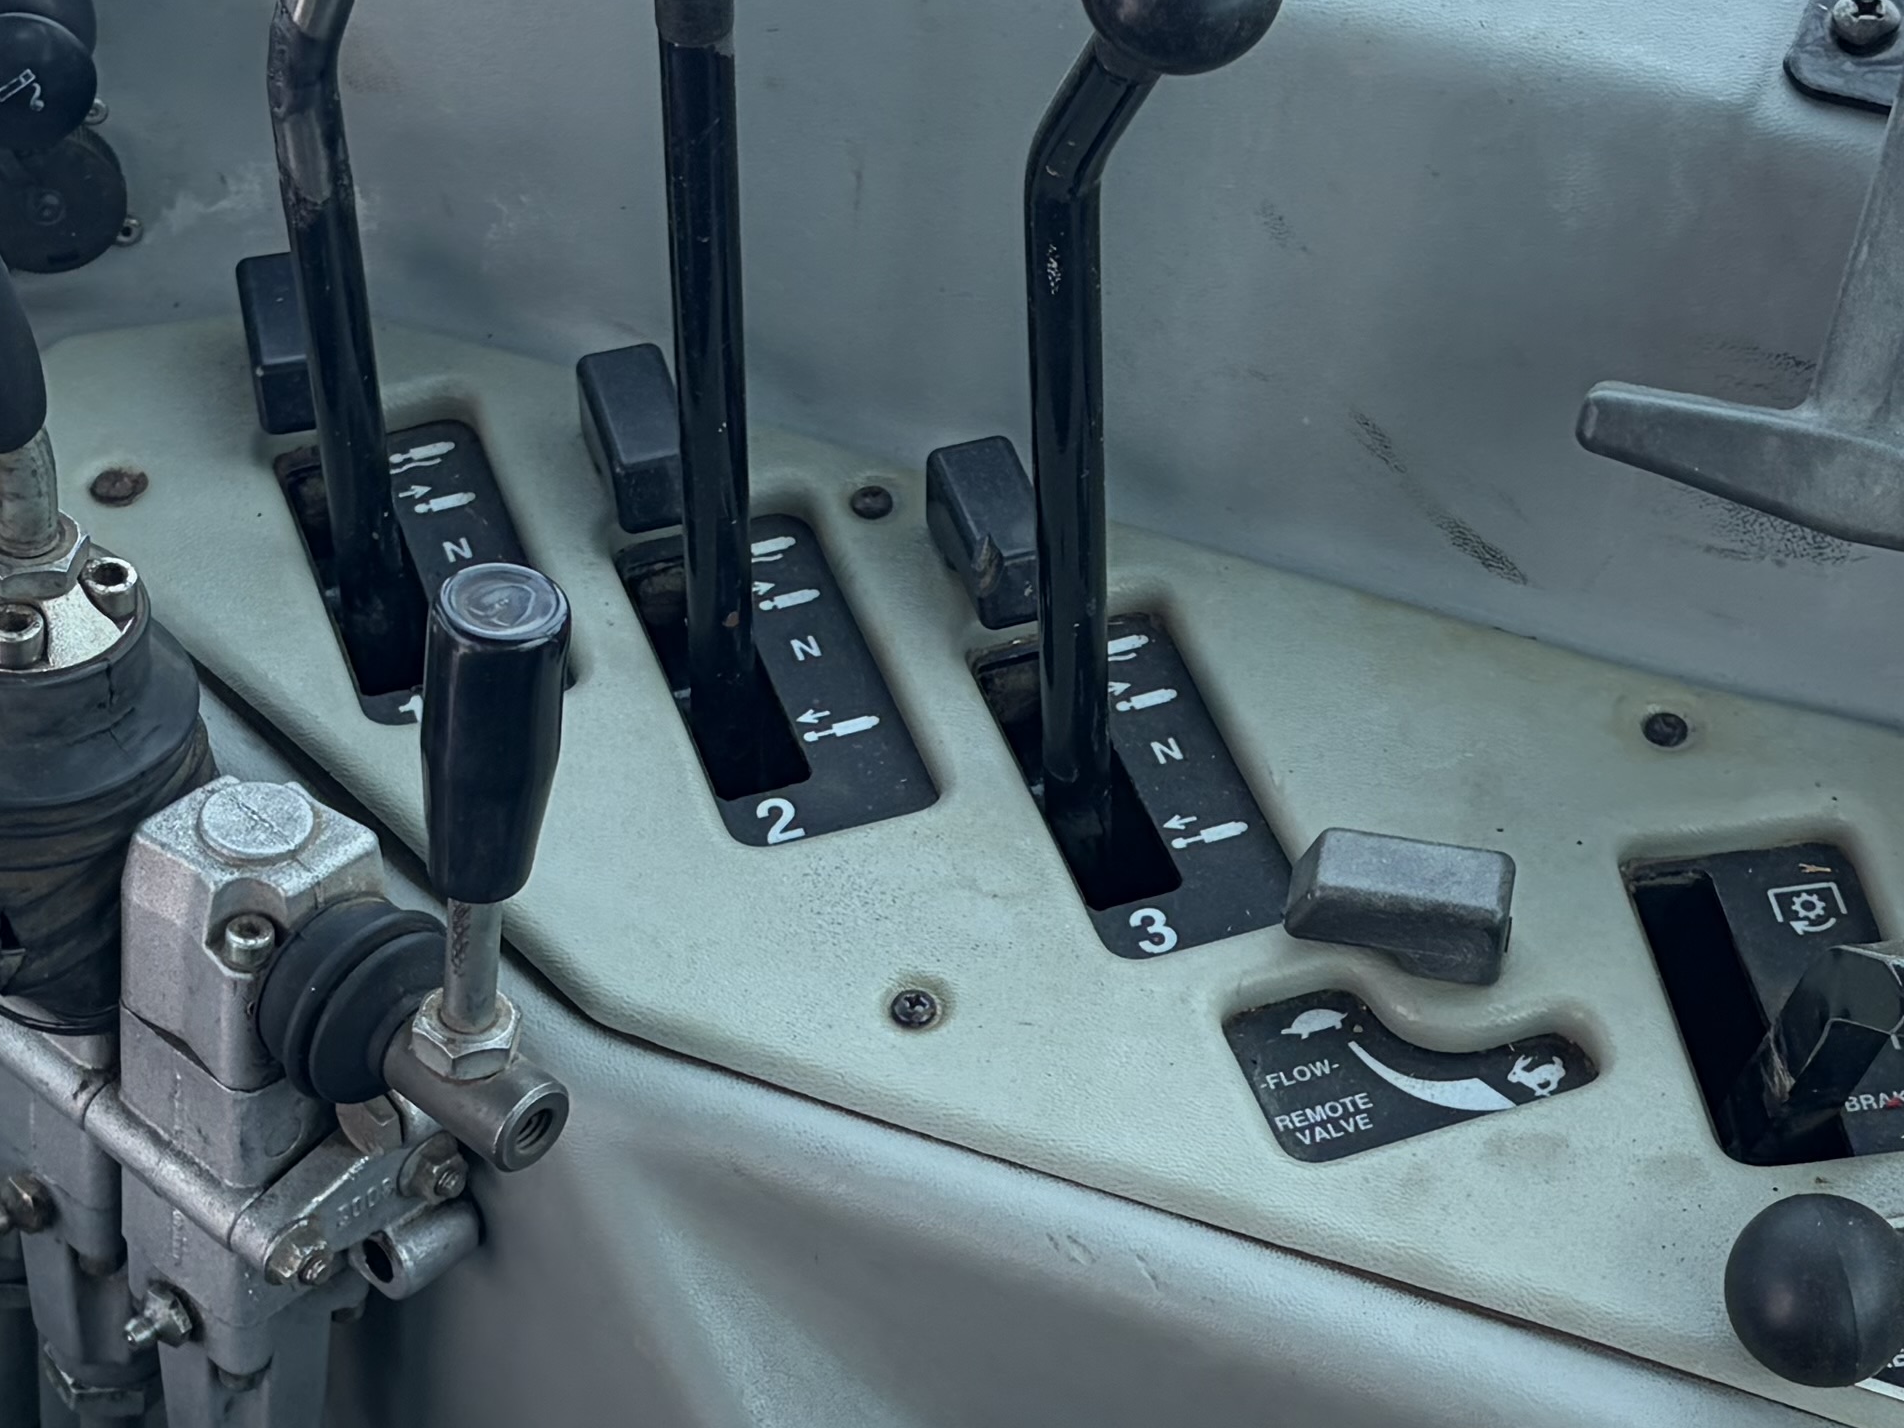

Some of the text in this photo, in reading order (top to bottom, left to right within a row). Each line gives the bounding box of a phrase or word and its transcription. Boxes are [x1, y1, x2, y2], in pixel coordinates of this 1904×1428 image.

[442, 537, 473, 563] N
[790, 635, 822, 661] N
[1150, 737, 1184, 764] N
[756, 797, 806, 845] 2
[1129, 907, 1178, 954] 3
[1260, 1059, 1340, 1090] -FLOW-
[1274, 1092, 1374, 1132] REMOTE
[1295, 1113, 1374, 1145] VALVE
